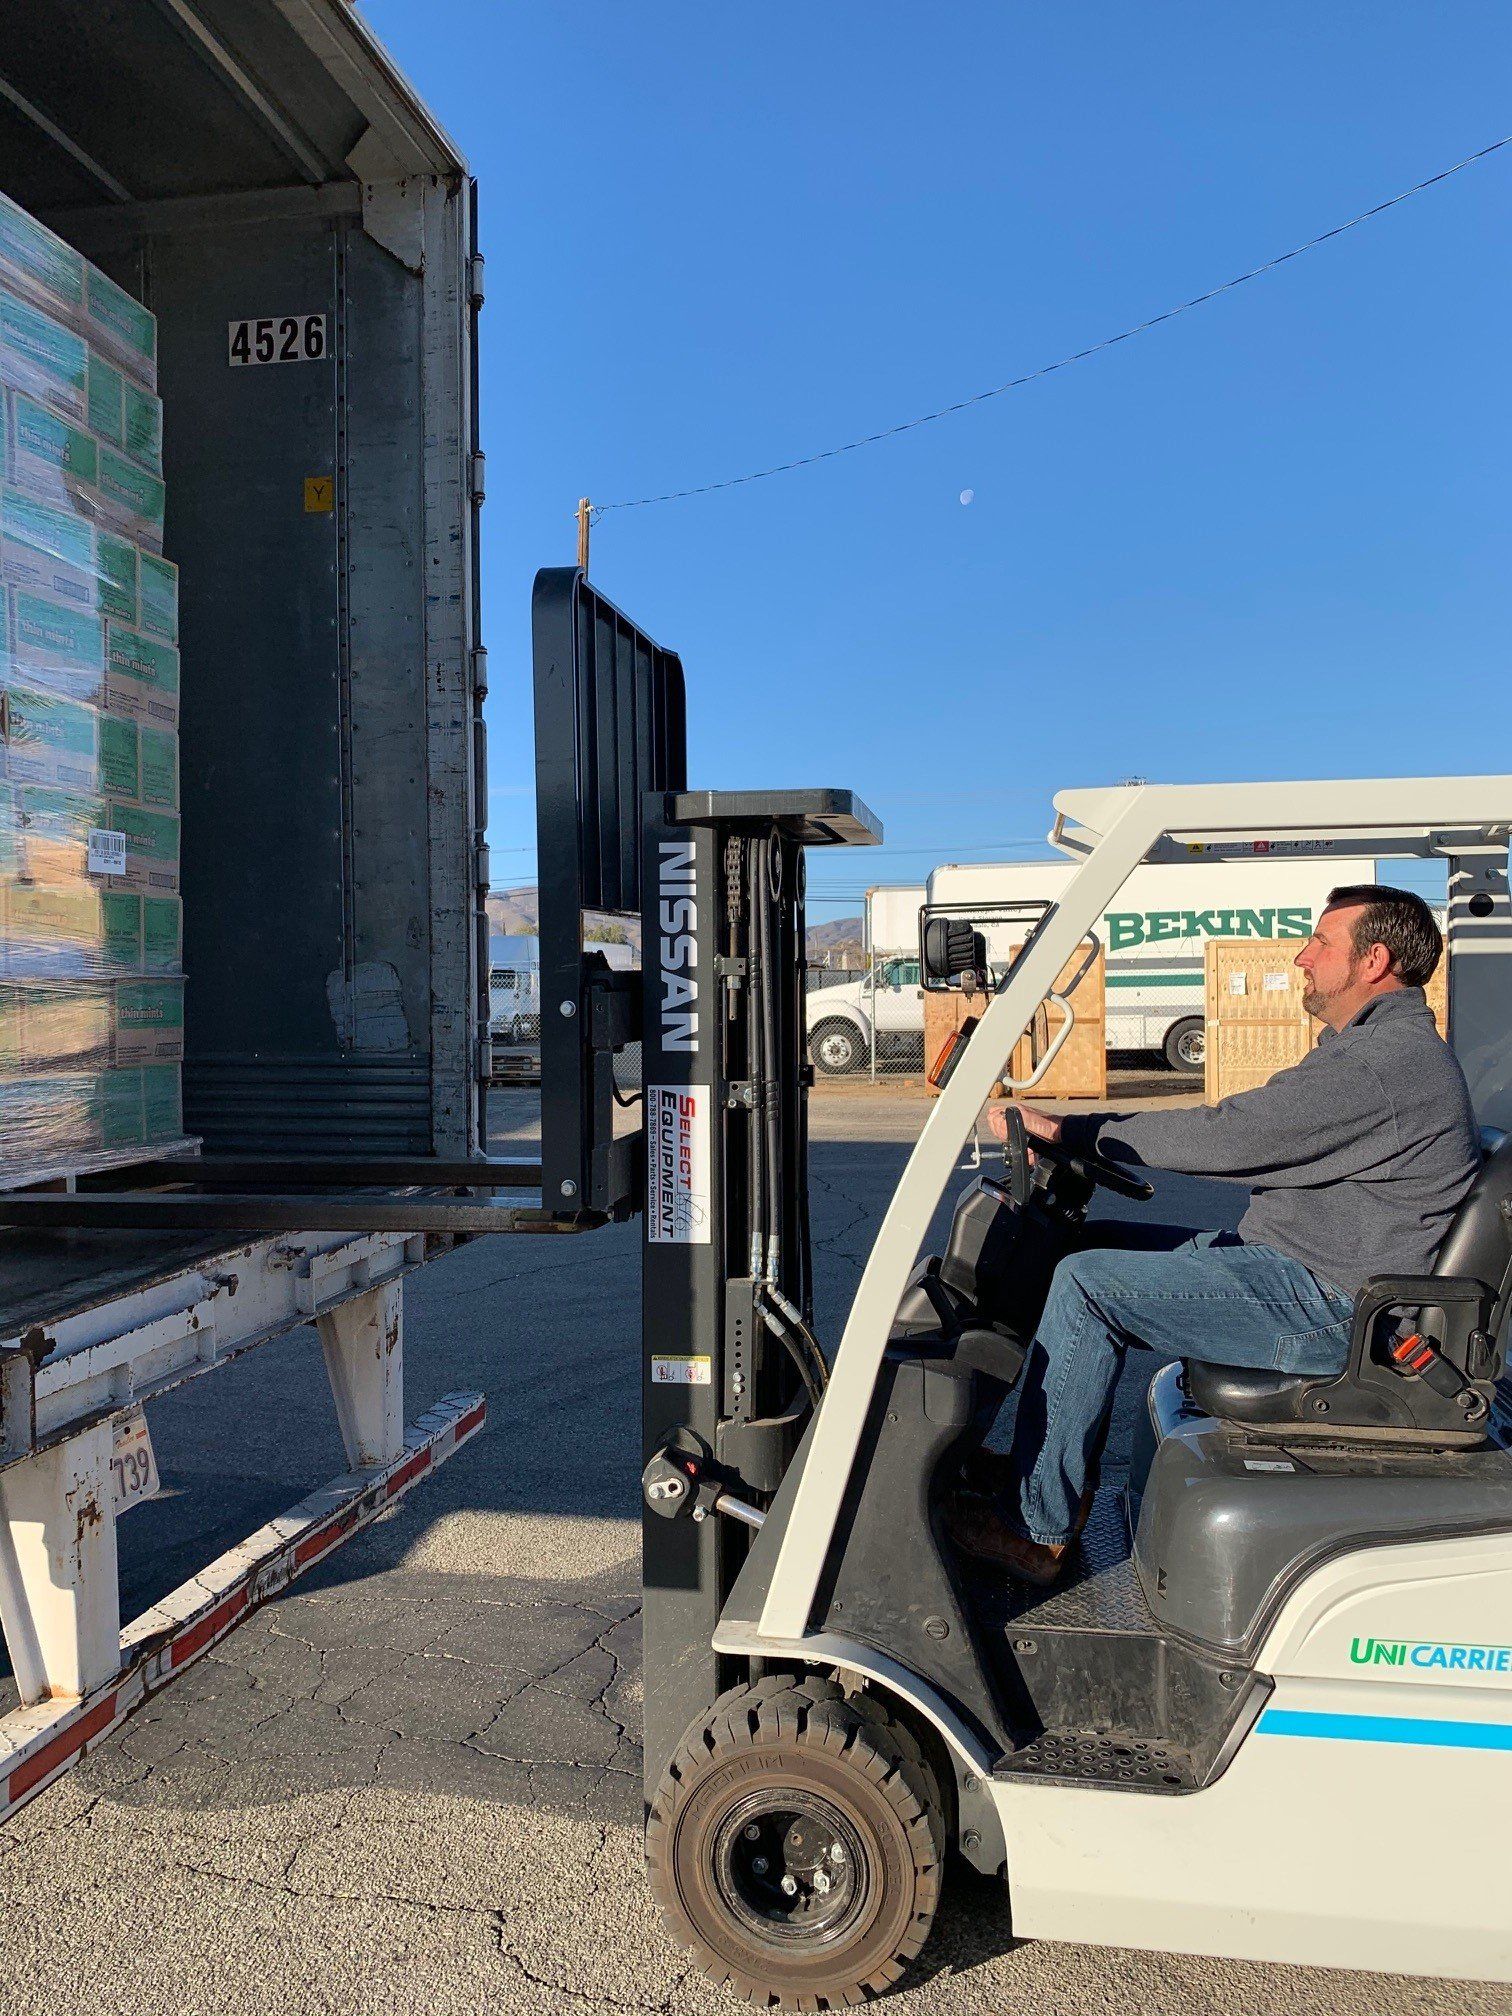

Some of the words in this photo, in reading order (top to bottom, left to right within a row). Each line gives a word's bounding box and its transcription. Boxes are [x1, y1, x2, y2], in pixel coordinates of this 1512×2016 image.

[231, 315, 324, 364] 4526
[313, 485, 325, 500] Y
[112, 651, 130, 667] thin
[132, 658, 157, 678] mints
[1103, 907, 1313, 953] BEKINS
[658, 841, 699, 1052] NISSAN
[649, 1140, 657, 1158] Sales
[680, 1094, 696, 1190] SELECT
[649, 1163, 657, 1181] Parts
[661, 1089, 677, 1238] EQUIPMENT
[649, 1185, 657, 1209] Service
[649, 1214, 657, 1239] Rentals
[1349, 1637, 1512, 1672] UNICARRIE
